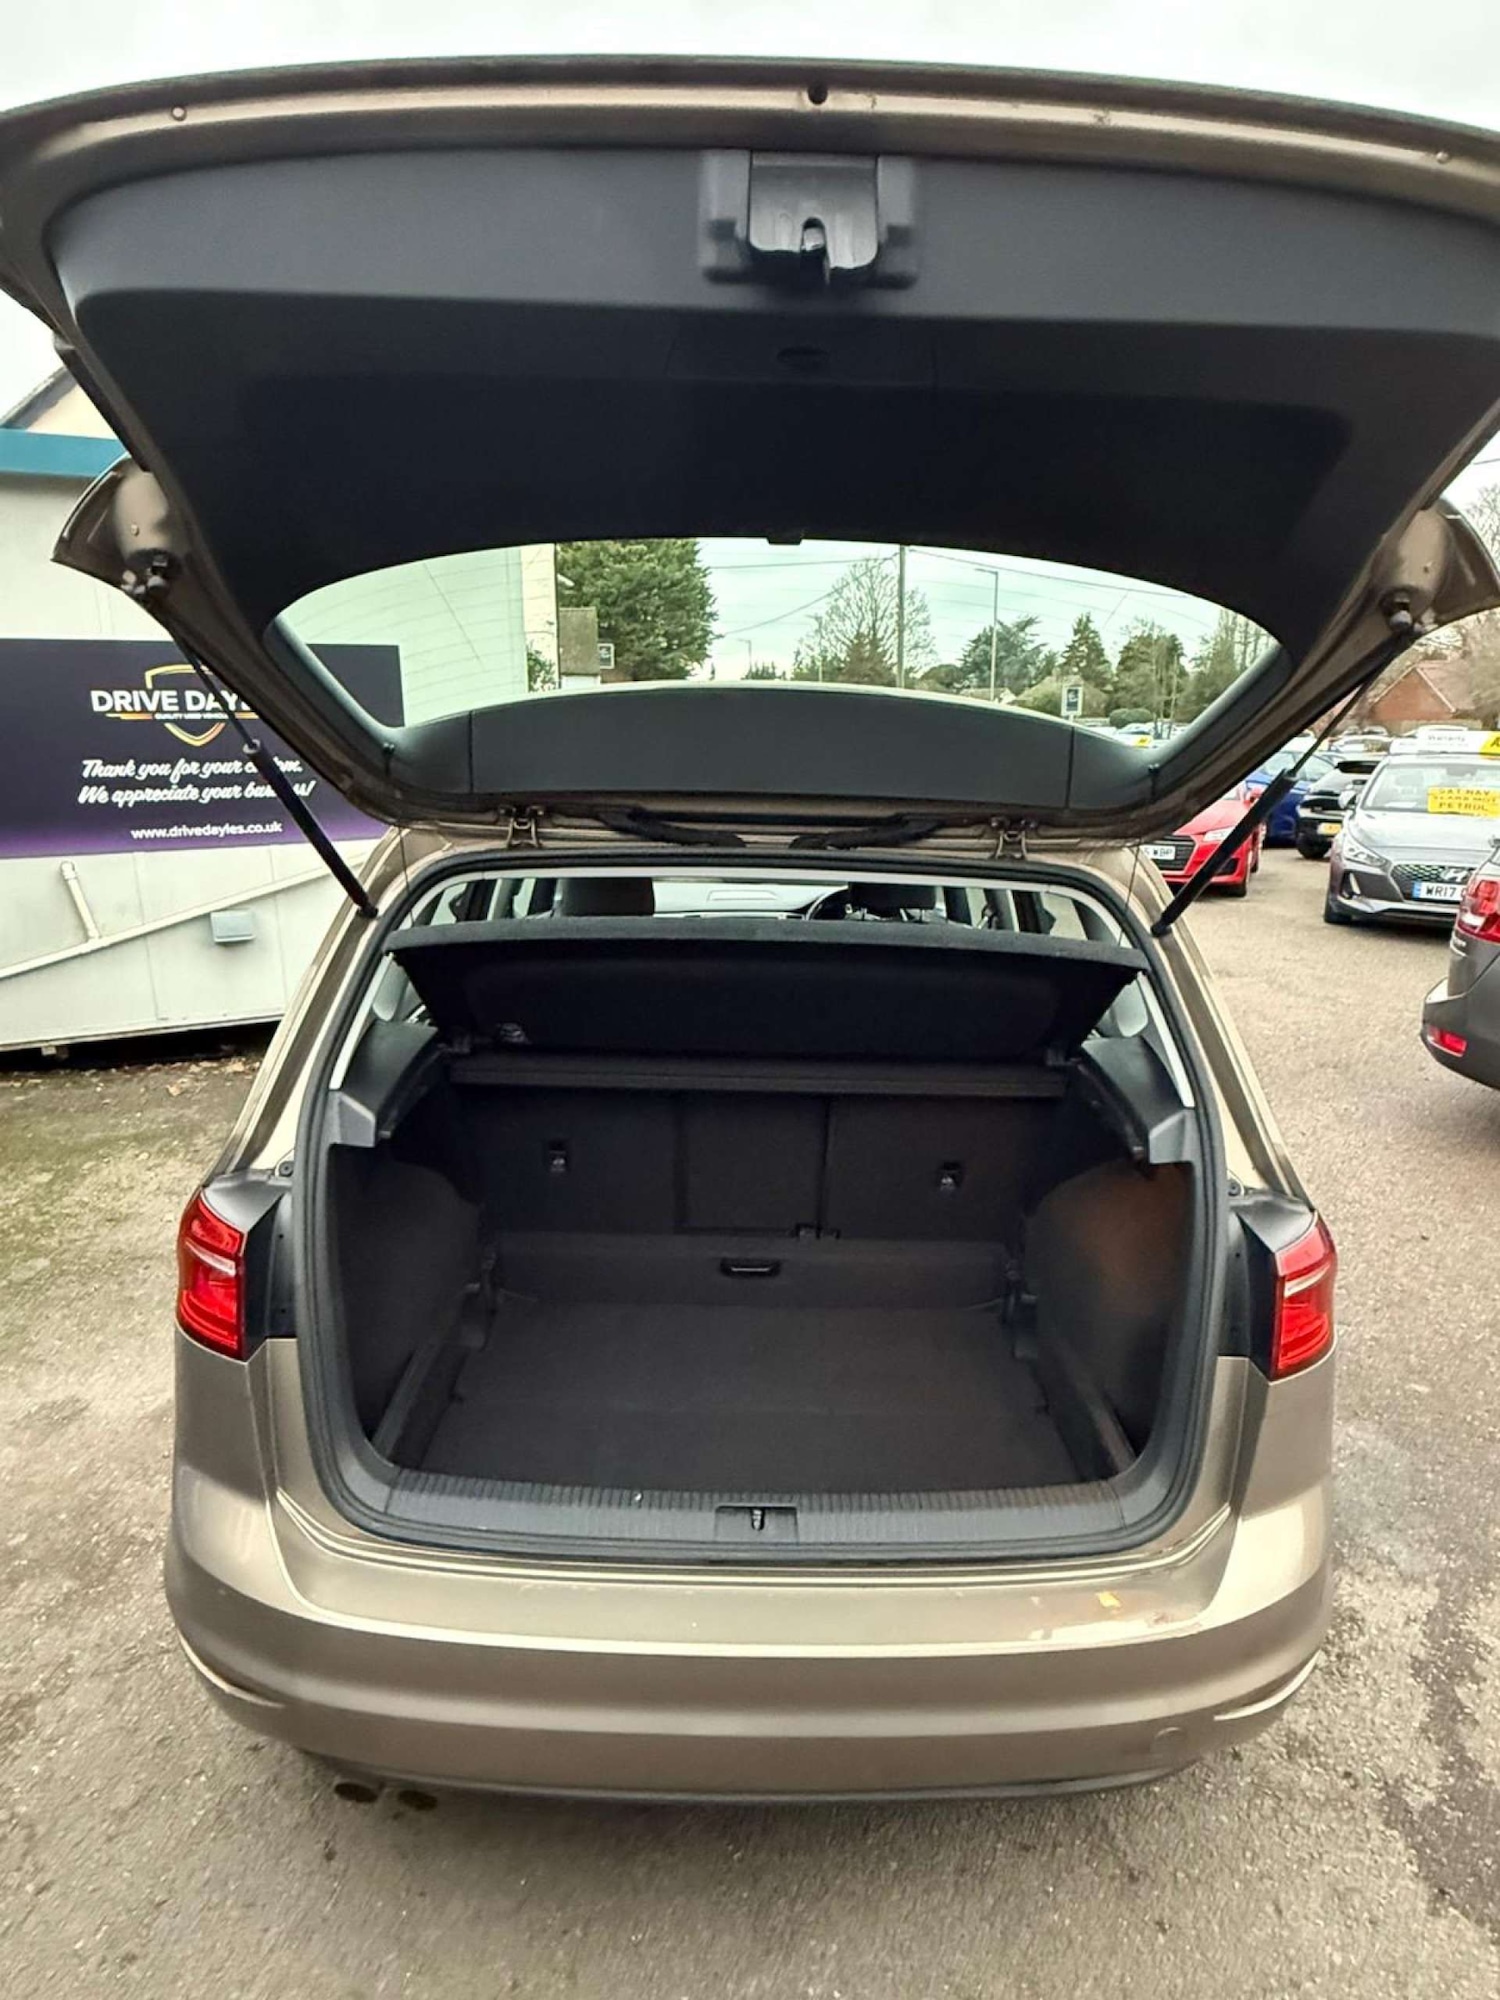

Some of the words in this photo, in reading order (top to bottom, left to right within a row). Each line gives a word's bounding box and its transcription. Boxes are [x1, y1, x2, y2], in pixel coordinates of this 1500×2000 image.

[91, 690, 179, 711] DRIVE
[82, 759, 135, 778] Thank
[135, 763, 172, 780] you
[170, 758, 200, 783] for
[199, 760, 242, 778] your
[78, 785, 109, 803] We
[112, 784, 199, 808] appreciate
[199, 785, 242, 803] your
[130, 820, 282, 839] www.drivedayles.co.uk
[1426, 885, 1457, 897] WR17
